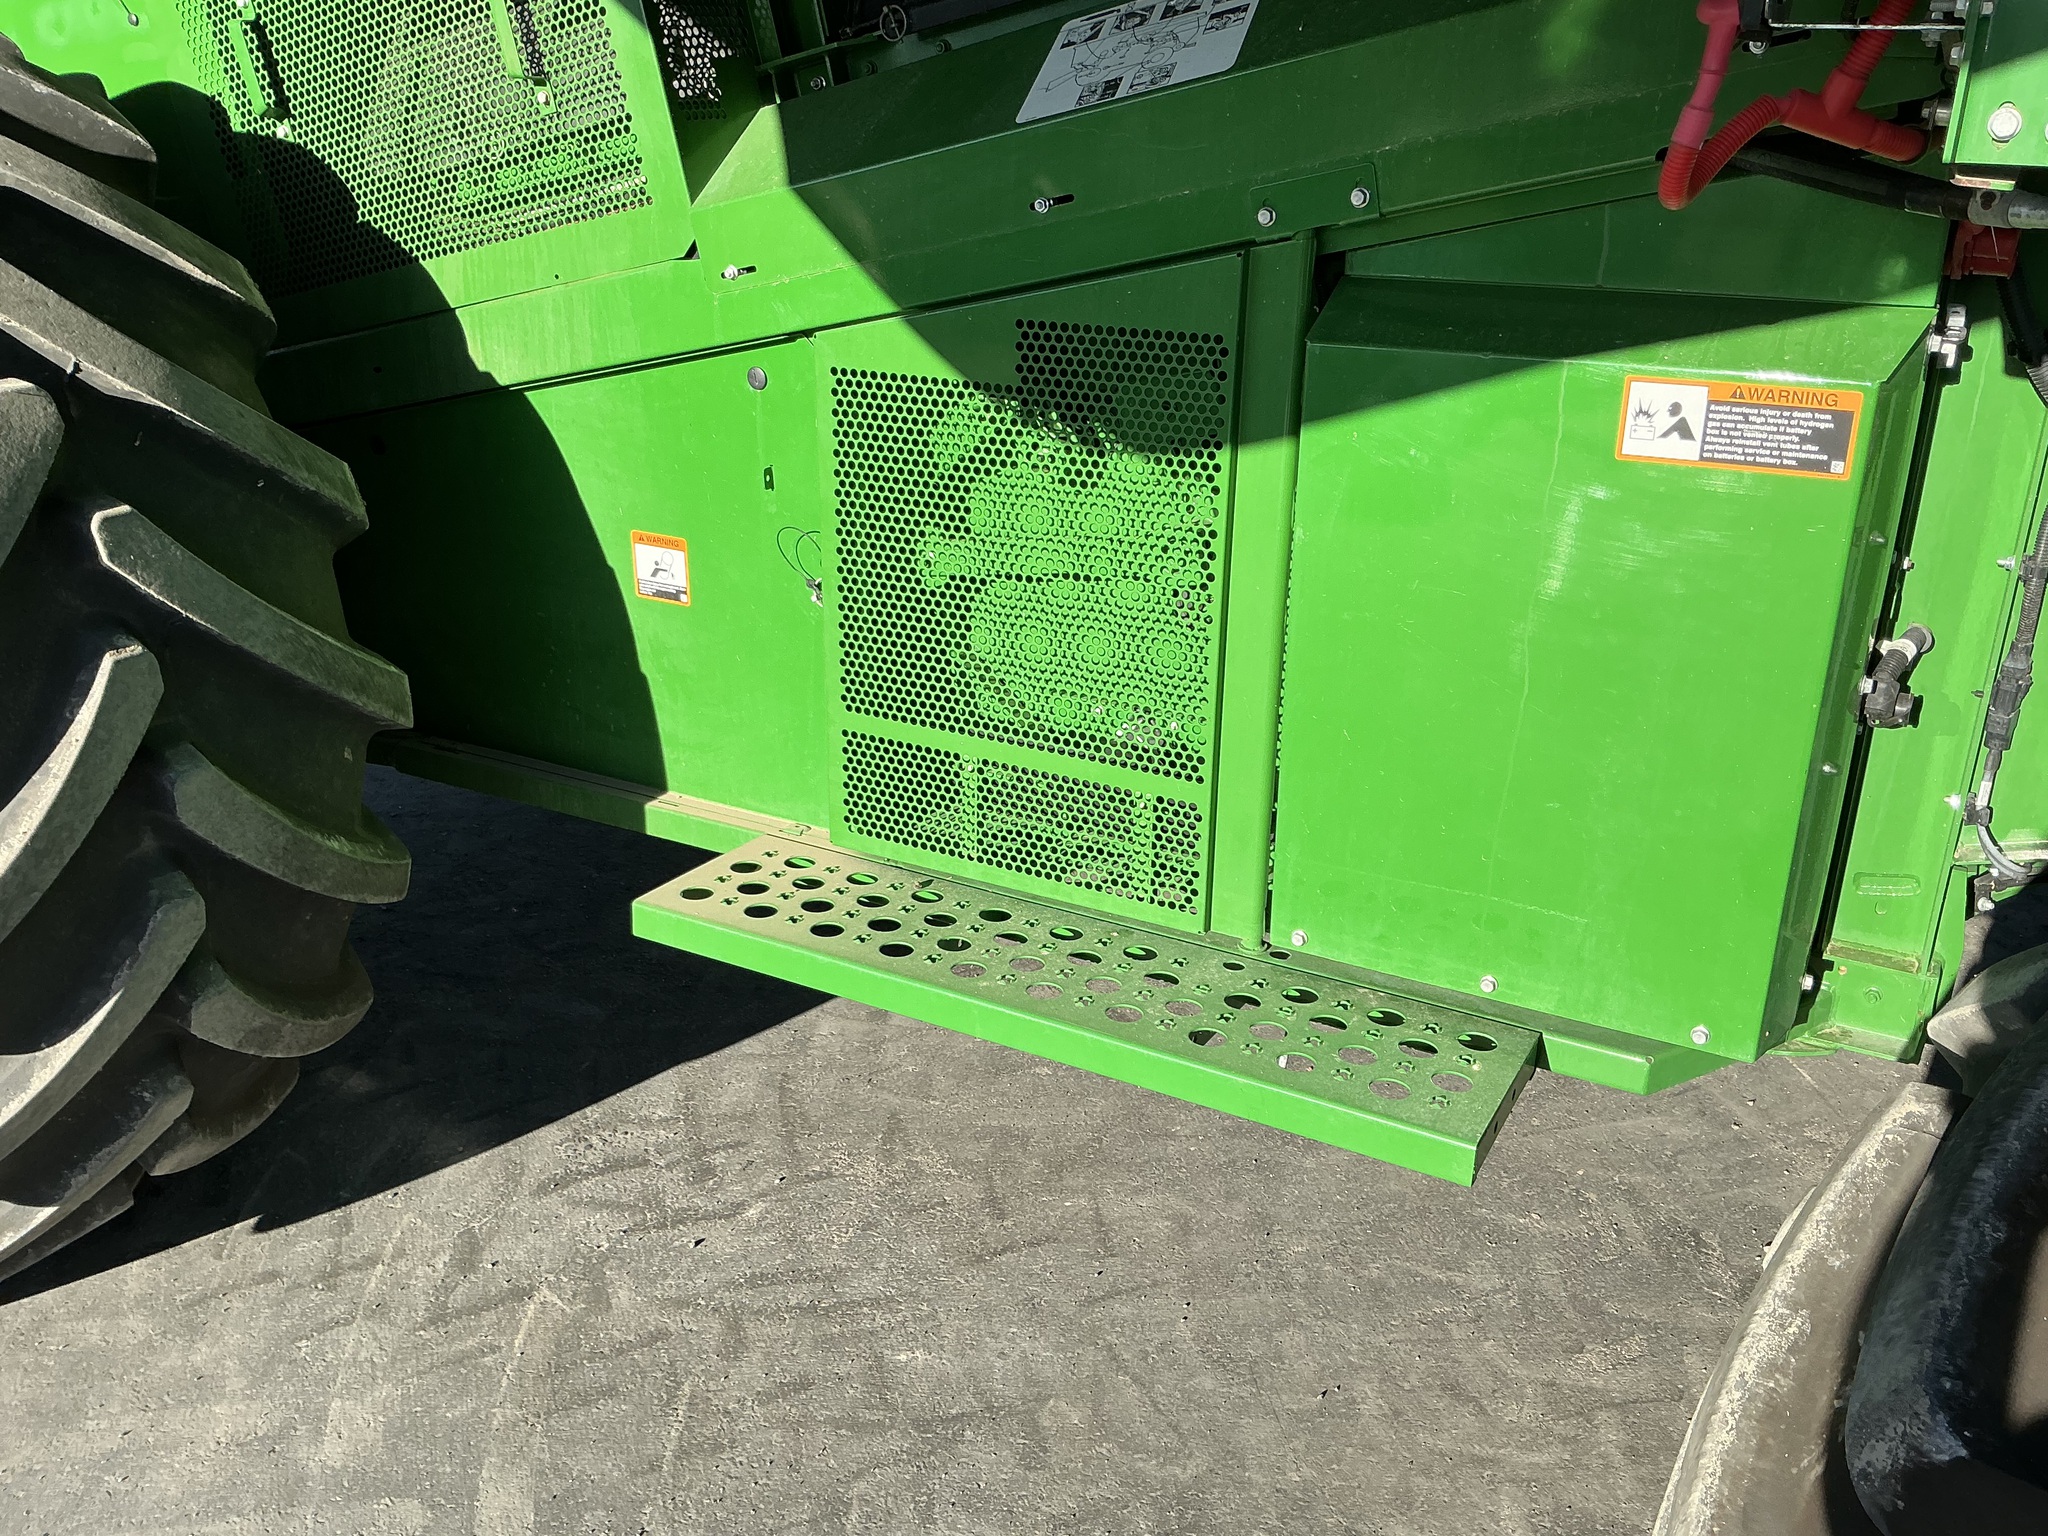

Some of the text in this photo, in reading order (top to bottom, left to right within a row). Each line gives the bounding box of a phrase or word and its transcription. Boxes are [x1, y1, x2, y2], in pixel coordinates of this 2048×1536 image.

[1748, 388, 1838, 407] WARNING
[1709, 404, 1731, 412] Avoid
[1731, 406, 1758, 414] serious
[1760, 408, 1781, 418] injury
[1814, 412, 1832, 420] from
[1708, 412, 1745, 421] explosion.
[1749, 415, 1766, 424] High
[1767, 417, 1789, 425] levels
[1800, 419, 1835, 430] hydrogen
[1736, 423, 1778, 432] accumulate
[1786, 427, 1812, 436] battery
[1705, 435, 1731, 444] Always
[1731, 438, 1761, 446] reinstall
[1743, 431, 1768, 439] vented
[1768, 434, 1800, 443] properly.
[1703, 444, 1743, 454] performing
[1744, 447, 1771, 455] service
[1781, 451, 1828, 461] maintenance
[1713, 452, 1745, 461] batteries
[1755, 456, 1781, 466] battery
[646, 536, 679, 548] WARNING
